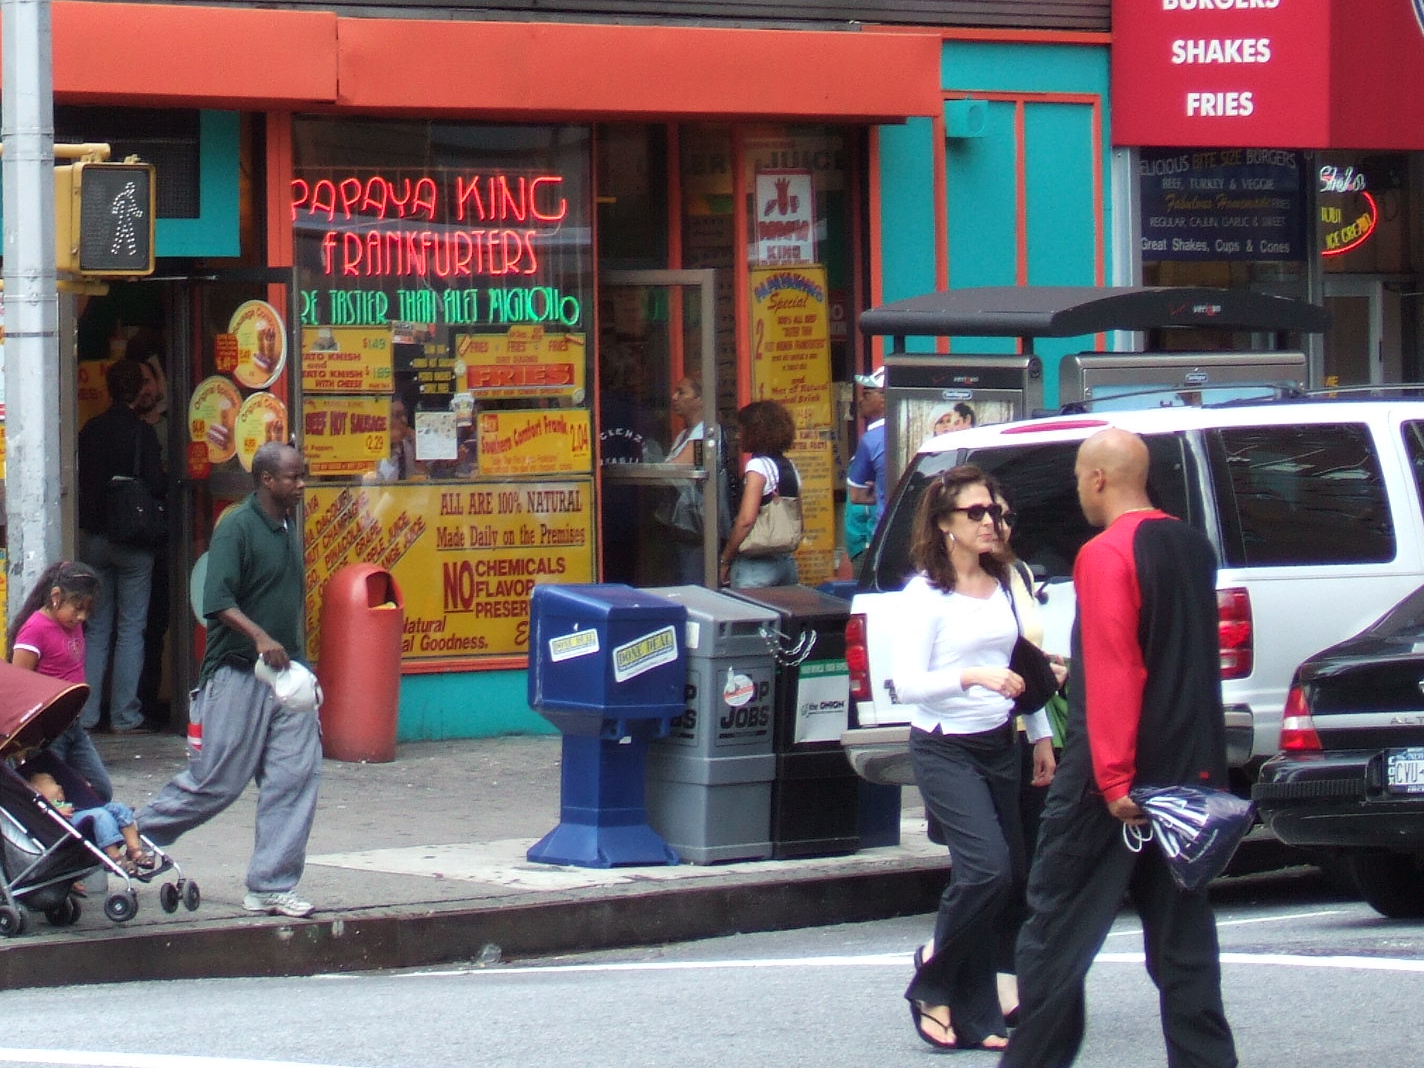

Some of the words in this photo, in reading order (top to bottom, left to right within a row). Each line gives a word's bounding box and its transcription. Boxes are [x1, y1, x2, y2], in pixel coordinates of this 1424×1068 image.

[1171, 38, 1271, 64] SHAKES
[1186, 92, 1253, 117] FRIES
[1139, 154, 1190, 176] ELICIOUS
[1246, 148, 1297, 170] BURGERS
[291, 176, 437, 222] PAPAYA
[457, 175, 568, 221] KING
[322, 229, 538, 277] FRANKFURTERS
[1141, 236, 1167, 251] Great
[1172, 237, 1210, 253] Shakes,
[1215, 239, 1241, 254] Cups
[1259, 239, 1291, 254] Cones
[329, 288, 389, 325] TASTIER
[397, 288, 437, 324] THAN
[440, 492, 464, 516] ALL
[469, 491, 493, 515] ARE
[498, 490, 522, 514] 100%
[526, 489, 583, 514] NATURAL
[436, 526, 465, 549] Made
[470, 525, 498, 552] Daily
[503, 530, 515, 546] on
[519, 524, 535, 546] the
[539, 523, 587, 547] Premises
[476, 556, 566, 577] CHEMICALS
[443, 559, 476, 610] NO
[403, 616, 447, 634] atural
[420, 633, 490, 652] Goodness.
[720, 706, 769, 729] JOBS
